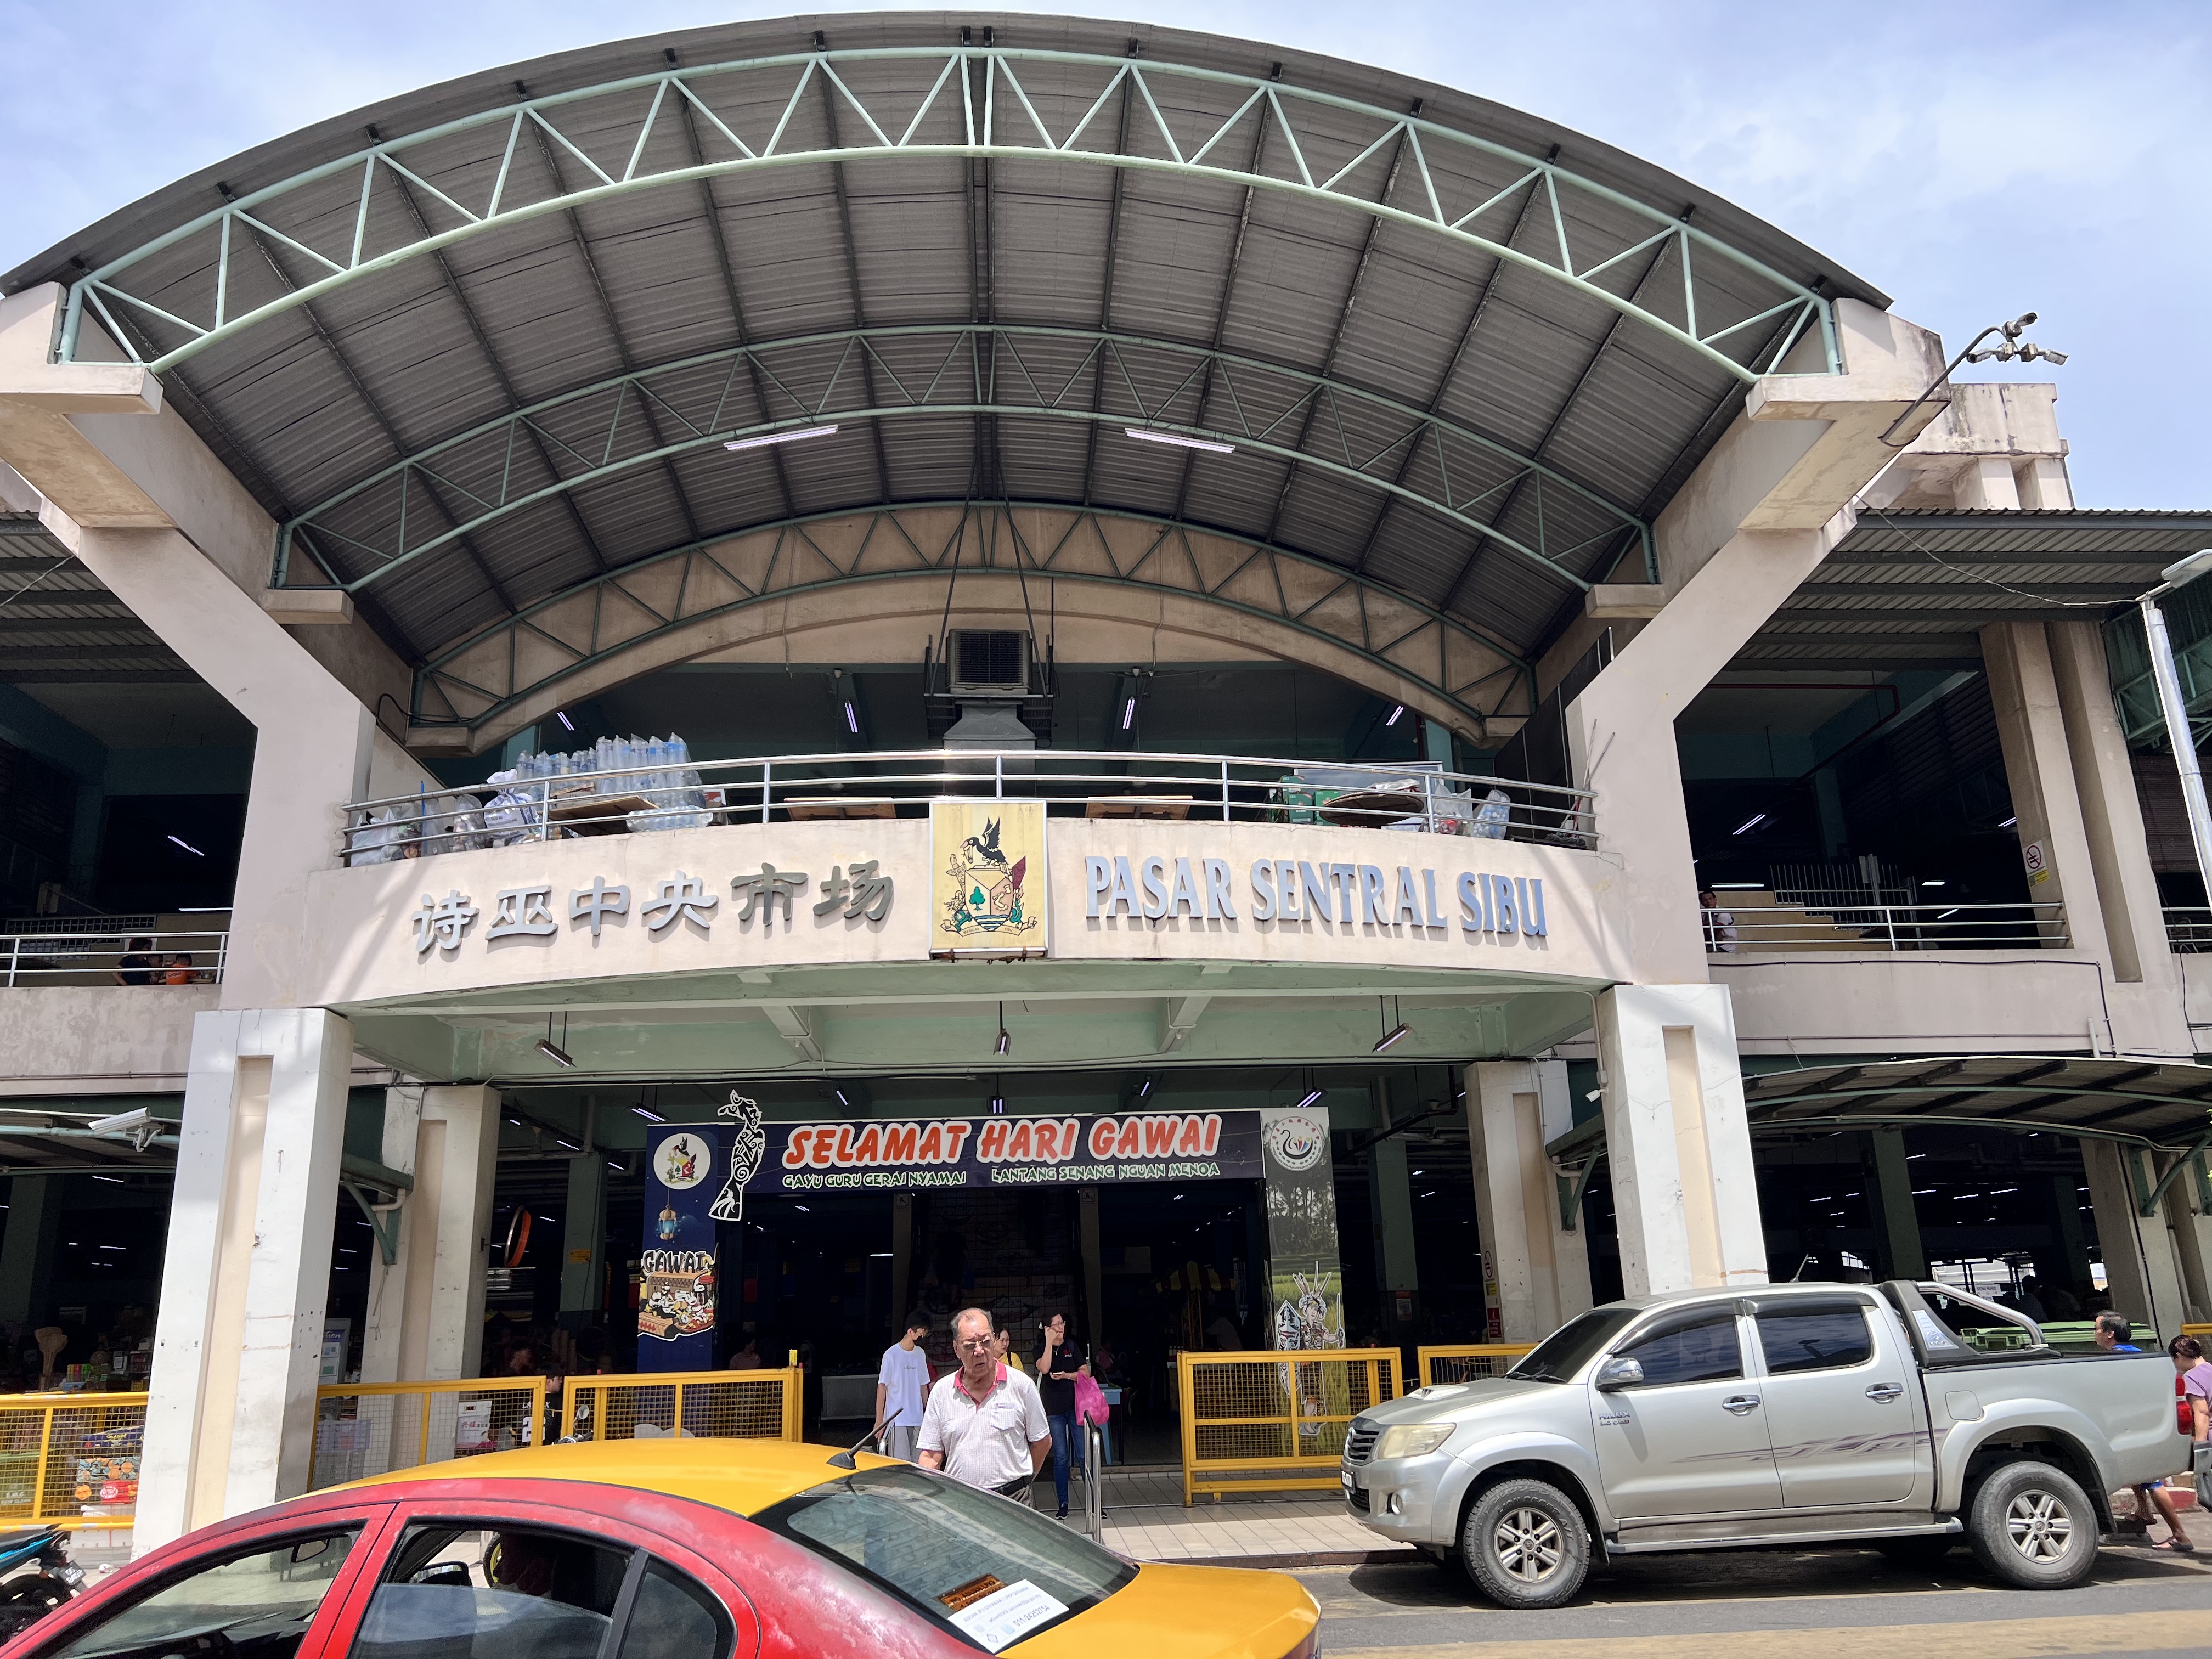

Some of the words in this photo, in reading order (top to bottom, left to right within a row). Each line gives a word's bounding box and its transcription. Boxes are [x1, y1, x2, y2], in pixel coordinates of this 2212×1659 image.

[411, 859, 894, 955] 诗巫中央市场
[1085, 855, 1239, 921] PASAR
[1251, 857, 1447, 929] SENTRAL
[1458, 871, 1548, 938] SIBU
[784, 1124, 969, 1166] SELAMAT
[979, 1121, 1077, 1162] HARI
[1091, 1116, 1220, 1158] GAWAI
[783, 1173, 823, 1189] GAYU
[825, 1173, 862, 1188] GURU
[863, 1172, 906, 1187] GERAI
[908, 1171, 966, 1187] NYAMAI
[991, 1167, 1057, 1183] LANTANG
[1059, 1164, 1114, 1181] SENANG
[1118, 1163, 1166, 1180] NGUAN
[1168, 1161, 1220, 1177] MENOA
[644, 1251, 705, 1273] GAWAI
[1523, 1496, 1561, 1515] SPORT
